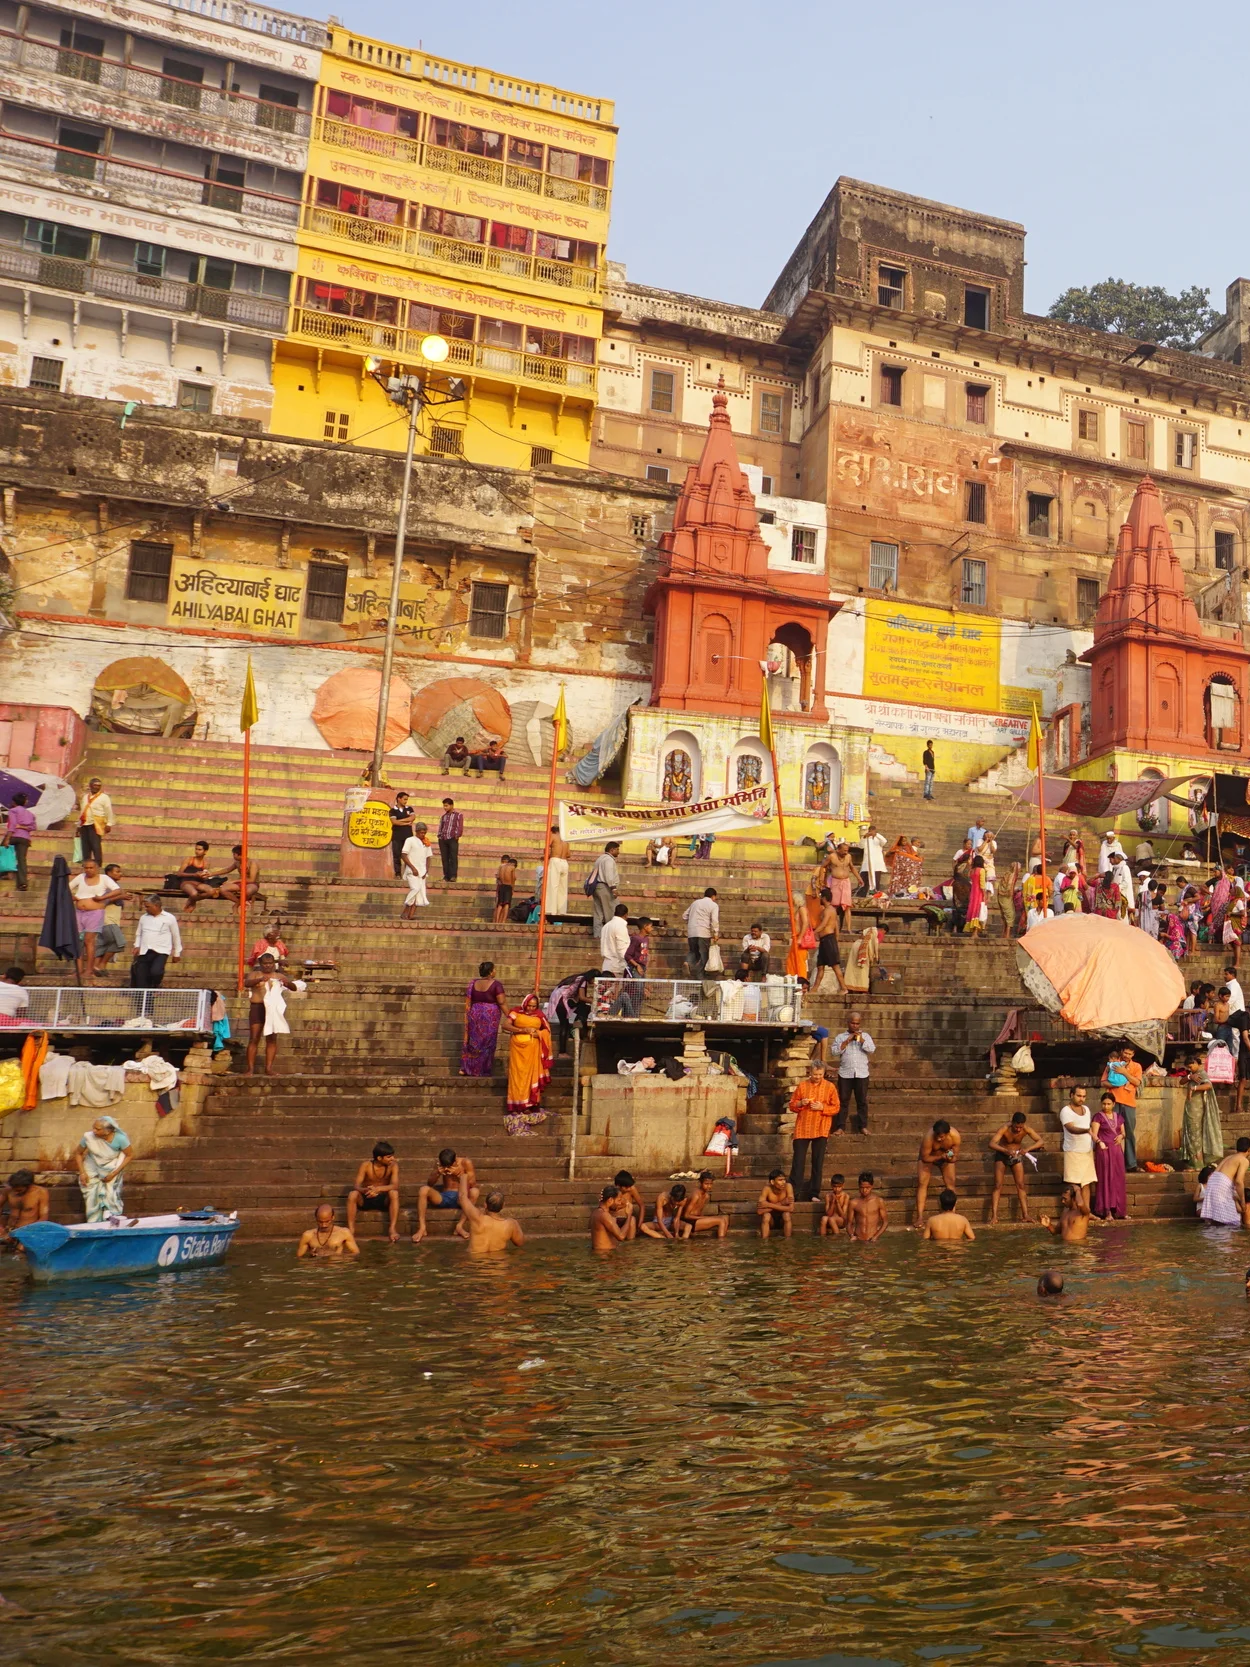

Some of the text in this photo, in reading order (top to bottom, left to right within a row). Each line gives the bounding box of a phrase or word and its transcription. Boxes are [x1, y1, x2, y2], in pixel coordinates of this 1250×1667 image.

[46, 197, 94, 217] मोहन
[174, 569, 302, 603] अहिल्याबाई घाट
[171, 600, 298, 630] AHILYABAI GHAT
[994, 718, 1028, 730] CREATIVE
[181, 1236, 210, 1260] State
